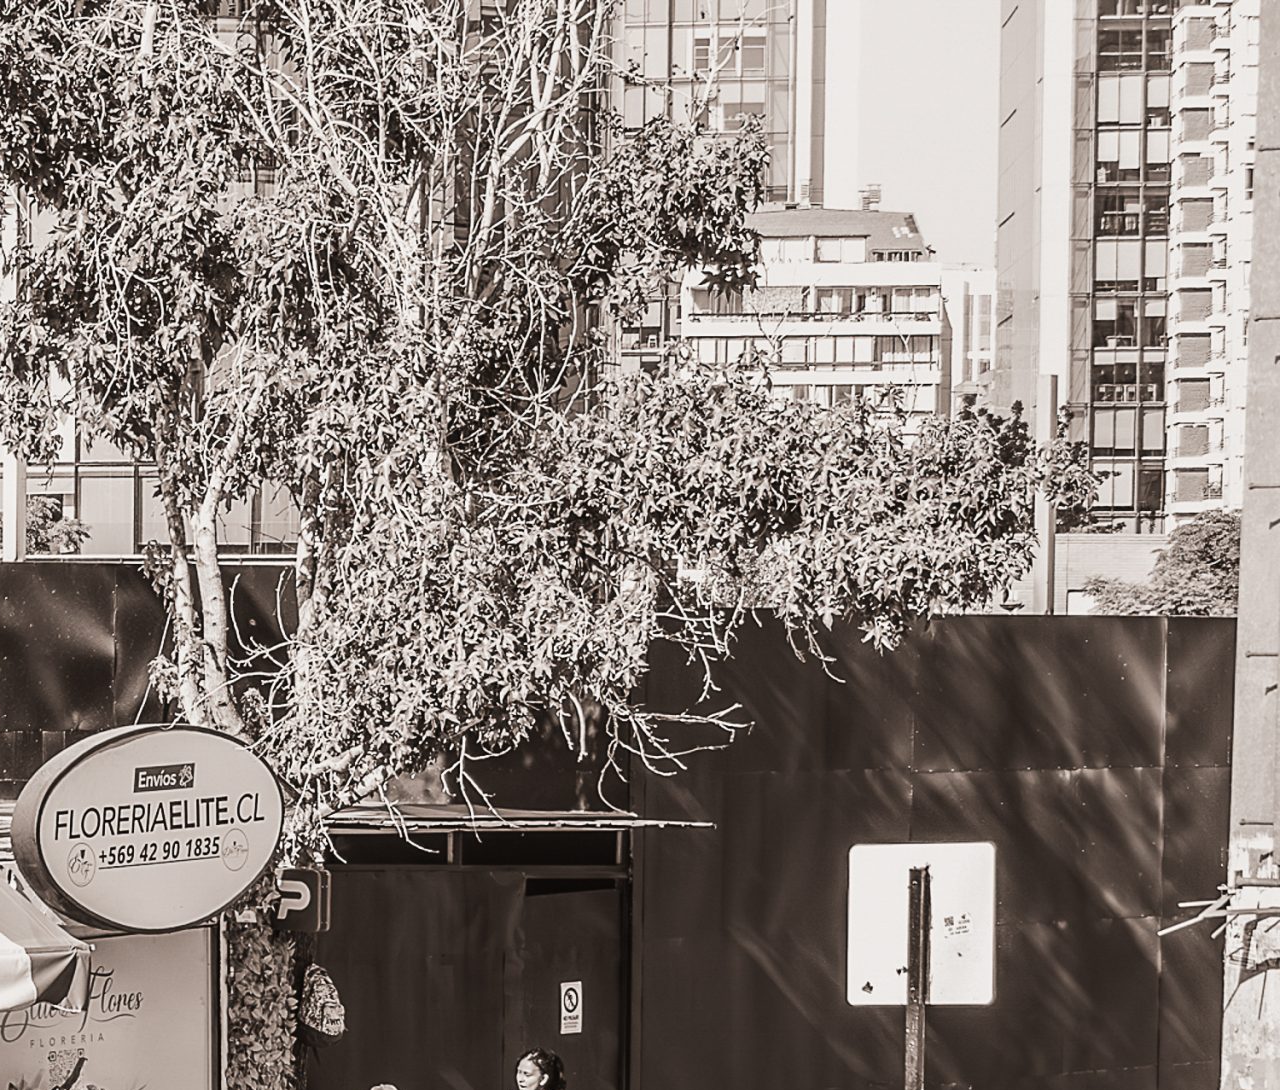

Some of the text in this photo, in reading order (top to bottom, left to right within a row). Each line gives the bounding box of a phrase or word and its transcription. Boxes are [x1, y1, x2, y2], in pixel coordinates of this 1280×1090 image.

[138, 770, 177, 789] Envíos
[55, 793, 265, 841] FLORERIAELITE.CL
[99, 845, 135, 866] +569
[139, 842, 158, 862] 42
[162, 840, 180, 860] 90
[185, 836, 220, 857] 1835
[277, 880, 311, 920] P
[29, 1033, 105, 1049] FLORERIA
